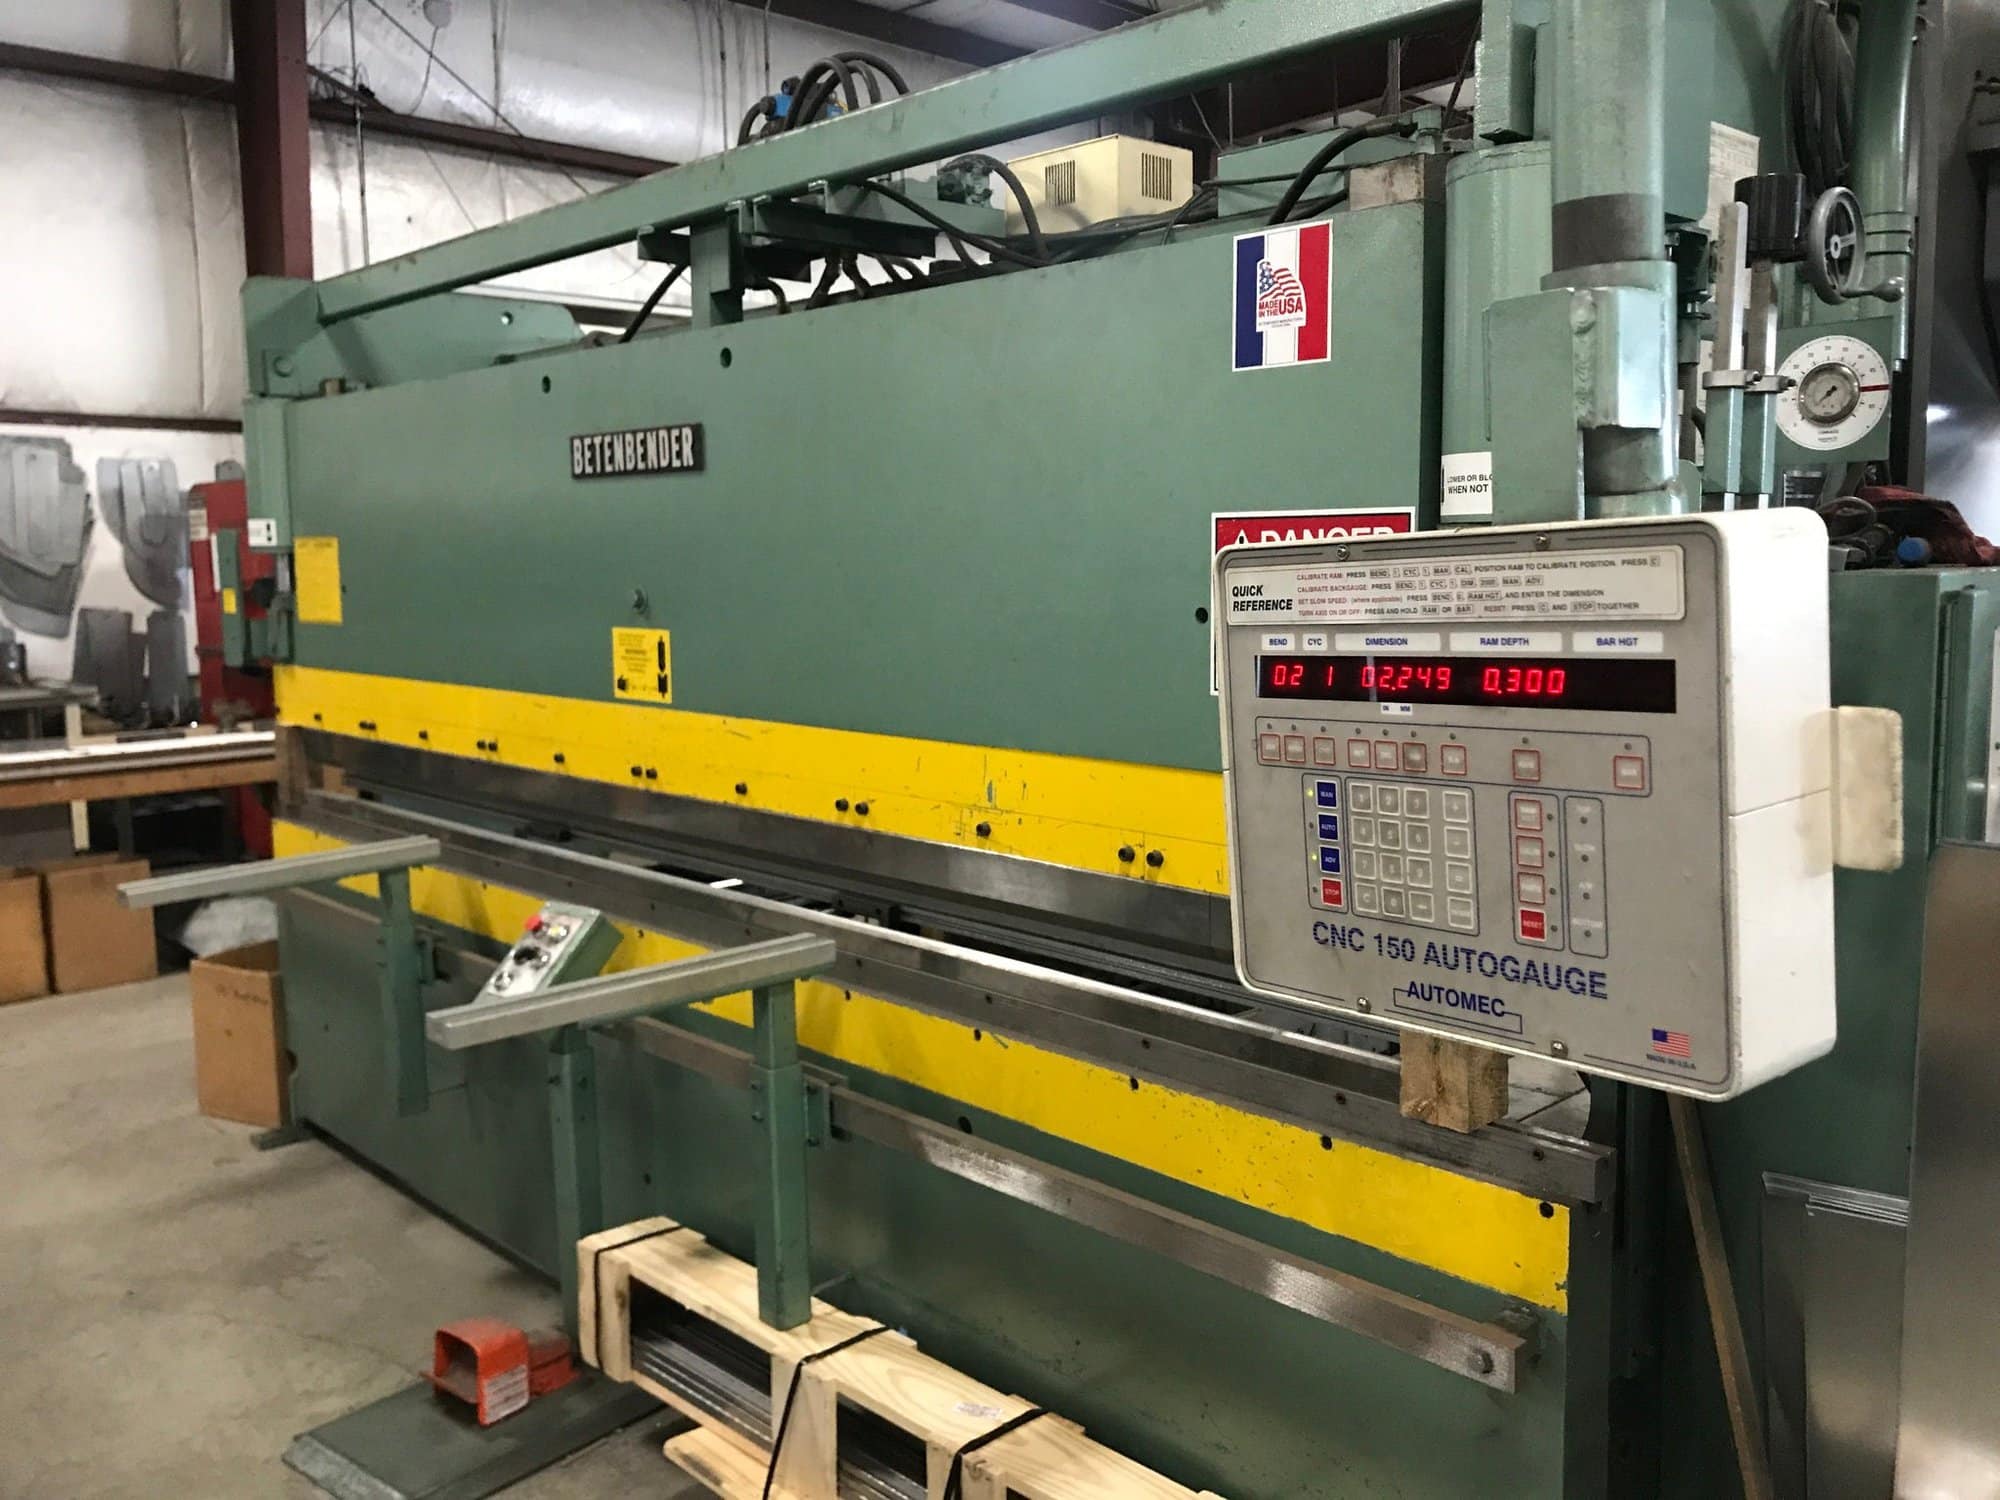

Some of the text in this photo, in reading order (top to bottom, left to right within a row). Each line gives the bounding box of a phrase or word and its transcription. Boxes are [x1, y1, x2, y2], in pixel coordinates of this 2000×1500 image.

[1258, 300, 1278, 310] MADE
[1279, 296, 1303, 315] USA
[572, 427, 694, 475] BETENBENDER
[1448, 484, 1488, 494] WHEN NOT
[1536, 561, 1577, 570] CALIBRATE
[1621, 558, 1648, 566] PRESS
[1232, 585, 1263, 598] QUICK
[1297, 585, 1328, 593] CALIBRATE
[1562, 589, 1604, 597] DIMENSION
[1233, 599, 1293, 612] REFERENCE
[1573, 602, 1593, 610] STOP
[1597, 602, 1640, 610] TOGETHER
[1269, 638, 1288, 646] BEND
[1307, 638, 1322, 646] CYC
[1365, 637, 1408, 646] DIMENSION
[1480, 637, 1530, 646] RAM DEPTH
[1596, 637, 1638, 647] BAR HGT
[1274, 665, 1304, 686] 02
[1361, 666, 1452, 691] 02.249
[1483, 668, 1566, 694] 0.300
[1321, 823, 1336, 832] AUTO
[1324, 888, 1340, 896] STOP
[1522, 920, 1543, 929] RESET
[1312, 921, 1608, 1000] CNC 150 AUTOGAUGE
[1407, 981, 1505, 1017] AUTOMEC
